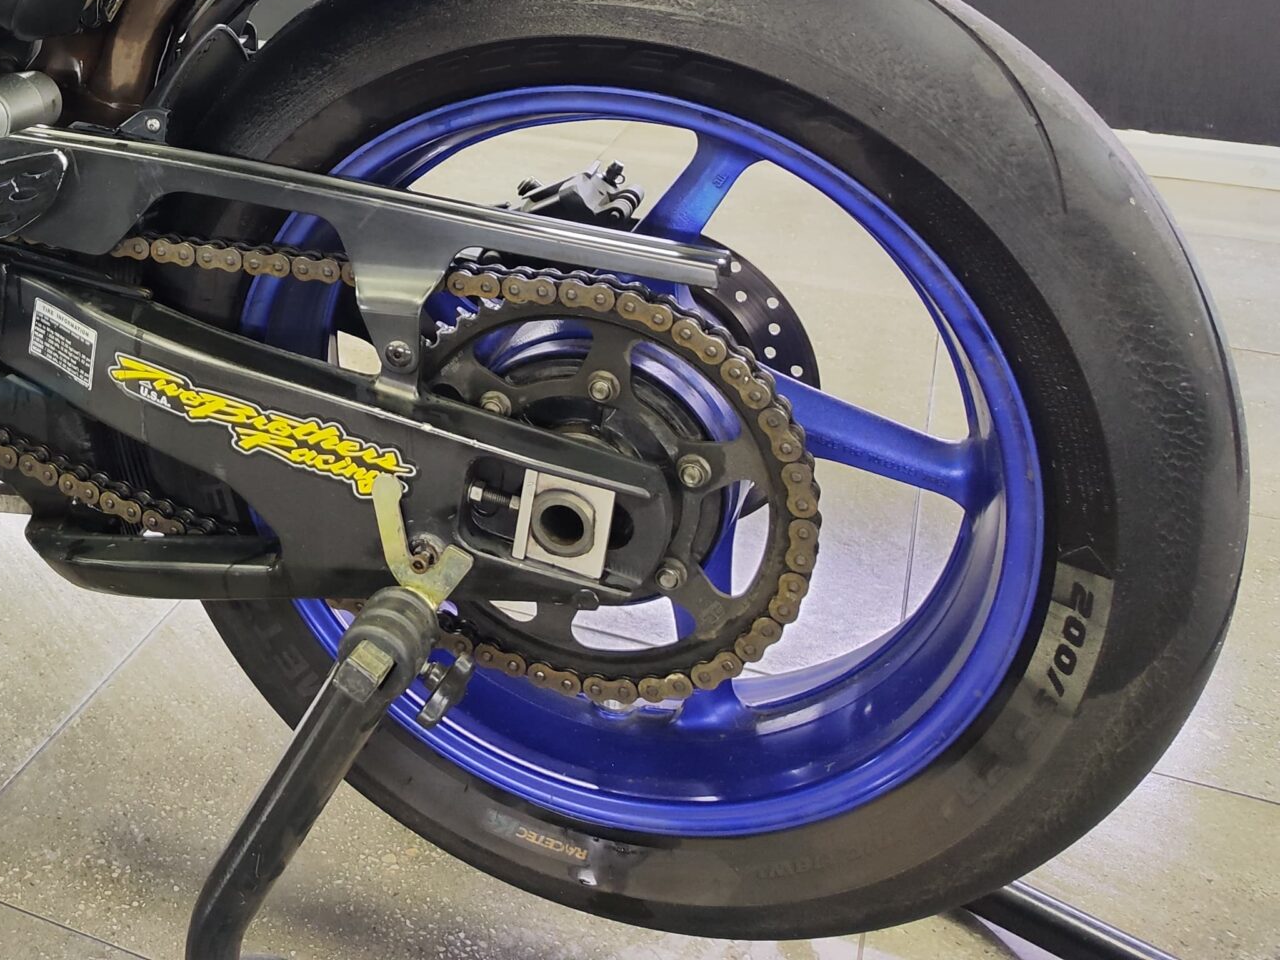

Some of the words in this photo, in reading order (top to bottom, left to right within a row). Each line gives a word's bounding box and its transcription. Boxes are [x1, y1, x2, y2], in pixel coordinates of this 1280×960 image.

[42, 305, 54, 316] TIRE
[56, 313, 90, 337] INFORMATION
[139, 385, 172, 408] U.S.A.
[185, 392, 414, 474] Brothers
[516, 826, 588, 861] RACETEC
